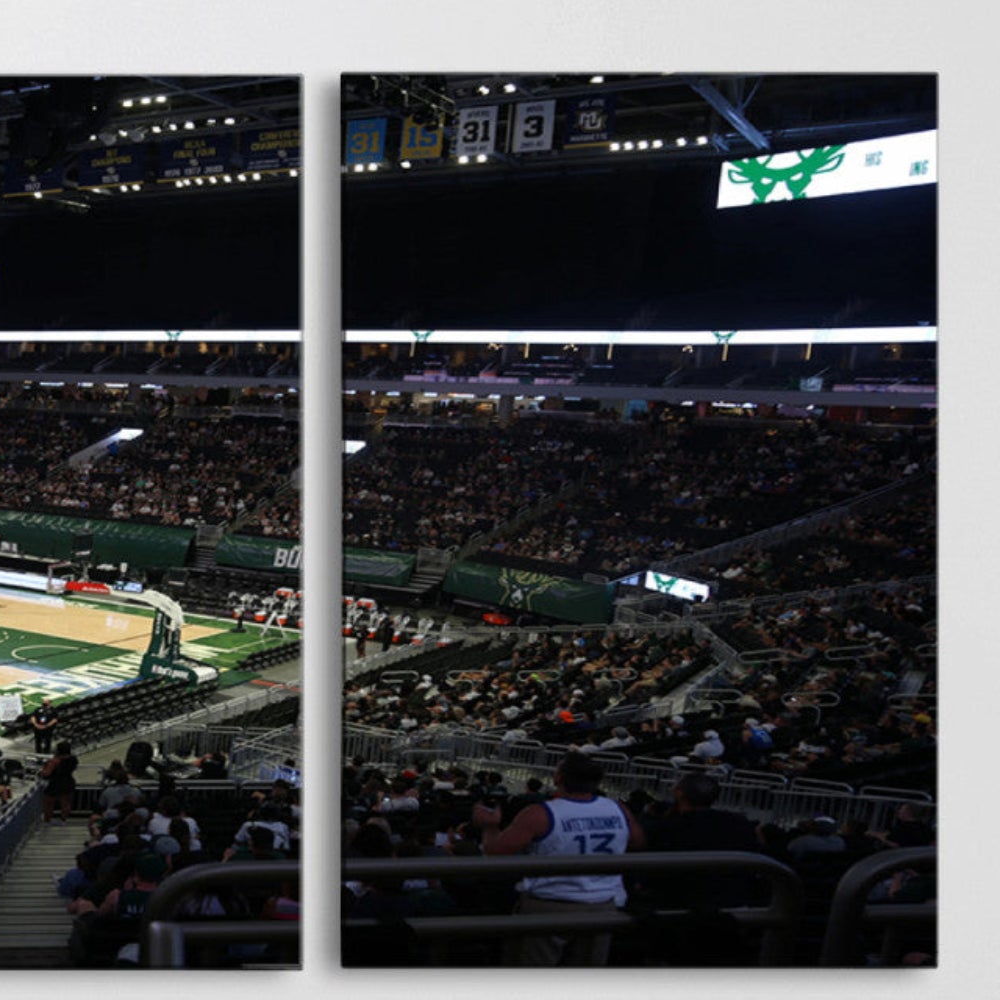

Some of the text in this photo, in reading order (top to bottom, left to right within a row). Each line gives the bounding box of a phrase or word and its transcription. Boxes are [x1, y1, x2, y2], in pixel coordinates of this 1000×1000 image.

[407, 126, 438, 148] 15
[463, 119, 491, 143] 31
[523, 115, 545, 138] 3
[350, 131, 380, 154] 31
